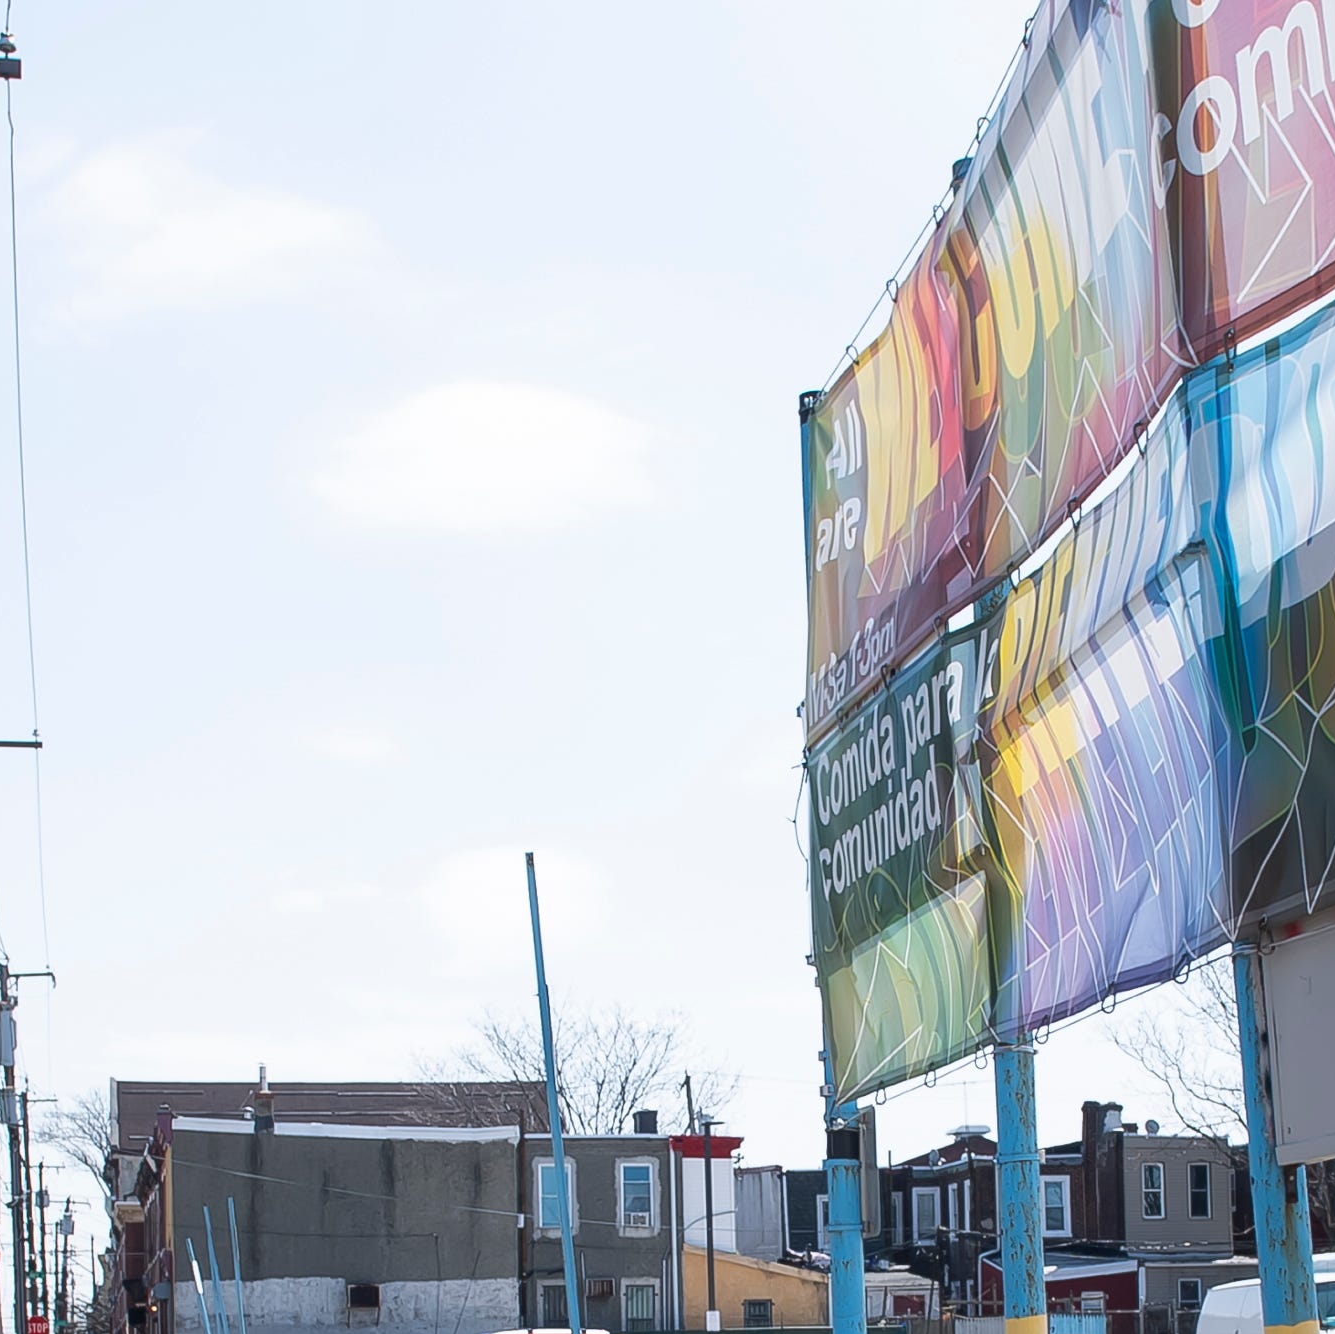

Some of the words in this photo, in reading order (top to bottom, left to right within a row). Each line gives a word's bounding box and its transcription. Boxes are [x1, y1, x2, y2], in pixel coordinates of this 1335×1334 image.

[825, 398, 862, 490] All
[815, 497, 862, 572] are
[817, 704, 896, 826] Comida
[901, 661, 963, 779] para
[819, 744, 942, 898] comunidad
[28, 1322, 49, 1334] STOP
